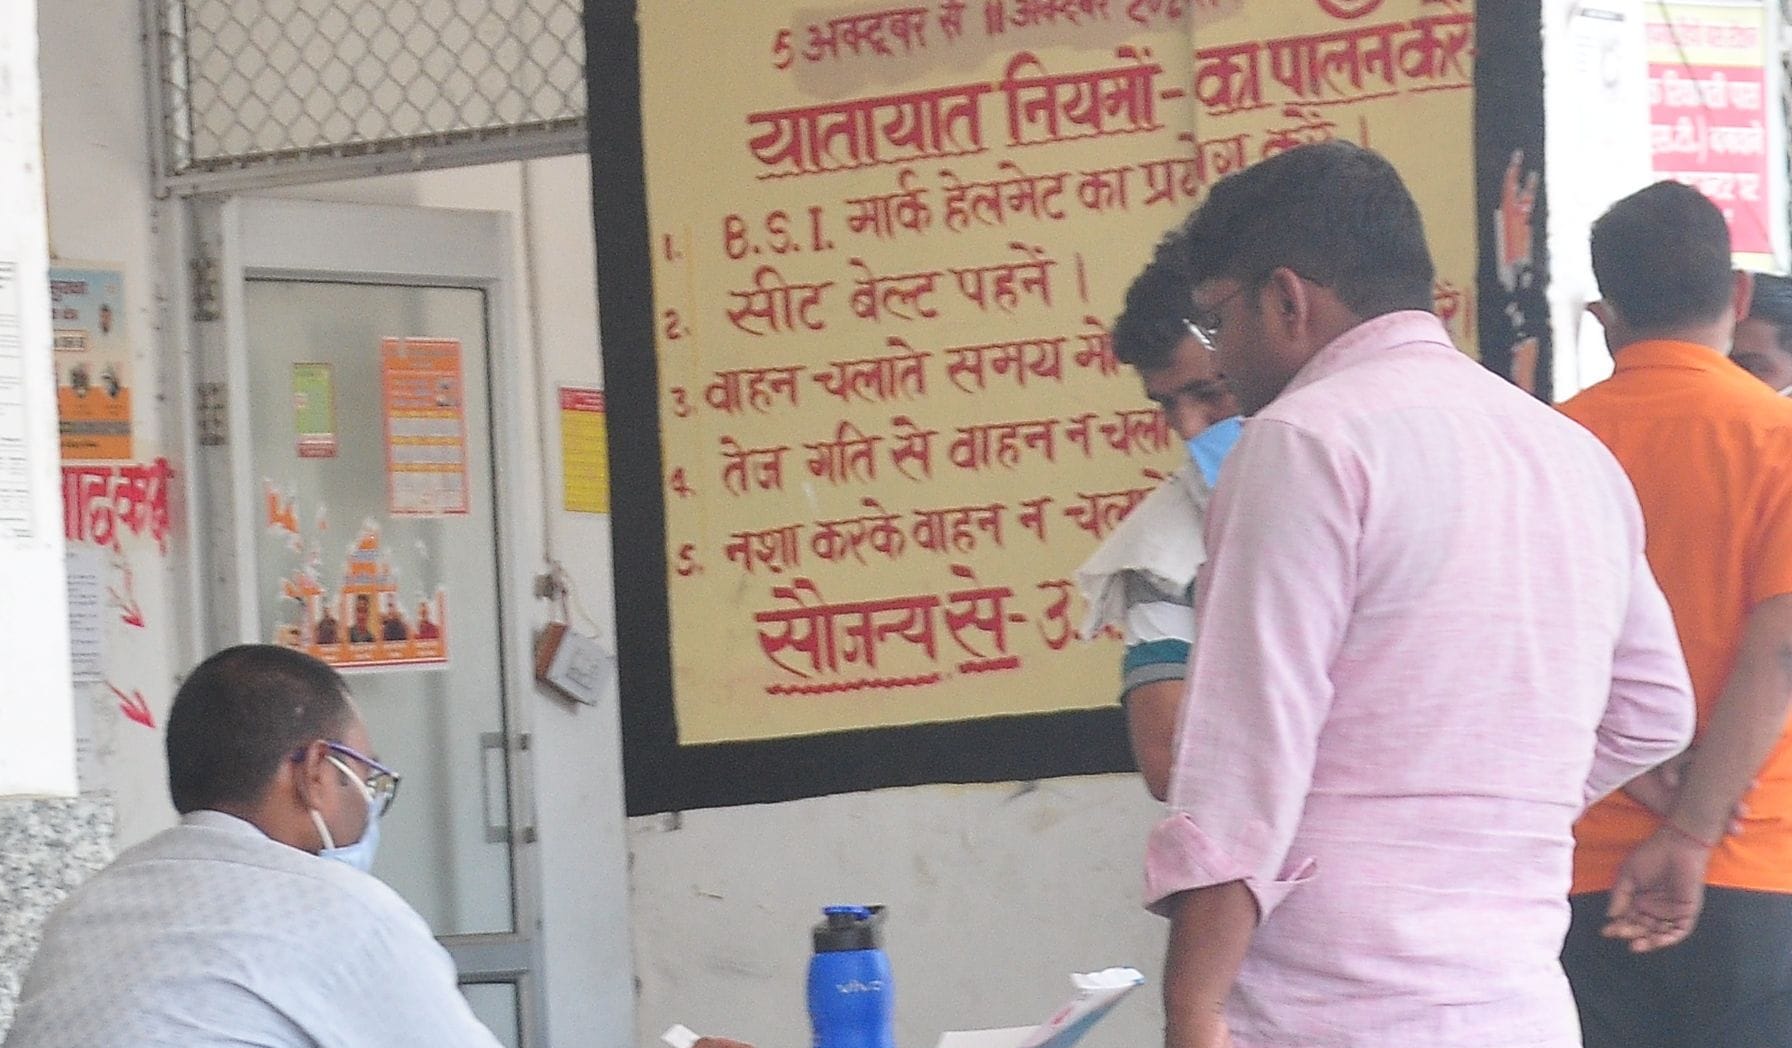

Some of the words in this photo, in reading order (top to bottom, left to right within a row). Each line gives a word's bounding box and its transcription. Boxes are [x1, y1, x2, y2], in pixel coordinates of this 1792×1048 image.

[747, 83, 994, 170] यातायात
[1194, 40, 1260, 107] का
[1266, 22, 1408, 97] पालन
[846, 168, 929, 240] मार्क
[938, 160, 1070, 233] हेलमेट
[1076, 167, 1134, 210] का
[727, 264, 835, 336] सीट
[848, 256, 944, 322] बेल्ट
[948, 242, 1057, 312] पहनें
[705, 365, 809, 413] वाहन
[813, 336, 933, 402] चलाते
[946, 336, 1067, 394] समय
[720, 435, 789, 496] तेज
[804, 420, 883, 484] गति
[891, 415, 939, 481] से
[948, 419, 1061, 476] वाहन
[1065, 412, 1099, 458] न
[724, 524, 805, 576] नशा
[811, 498, 905, 566] करके
[912, 503, 1007, 553] वाहन
[1018, 497, 1054, 540] न
[756, 577, 940, 678] सौजन्य
